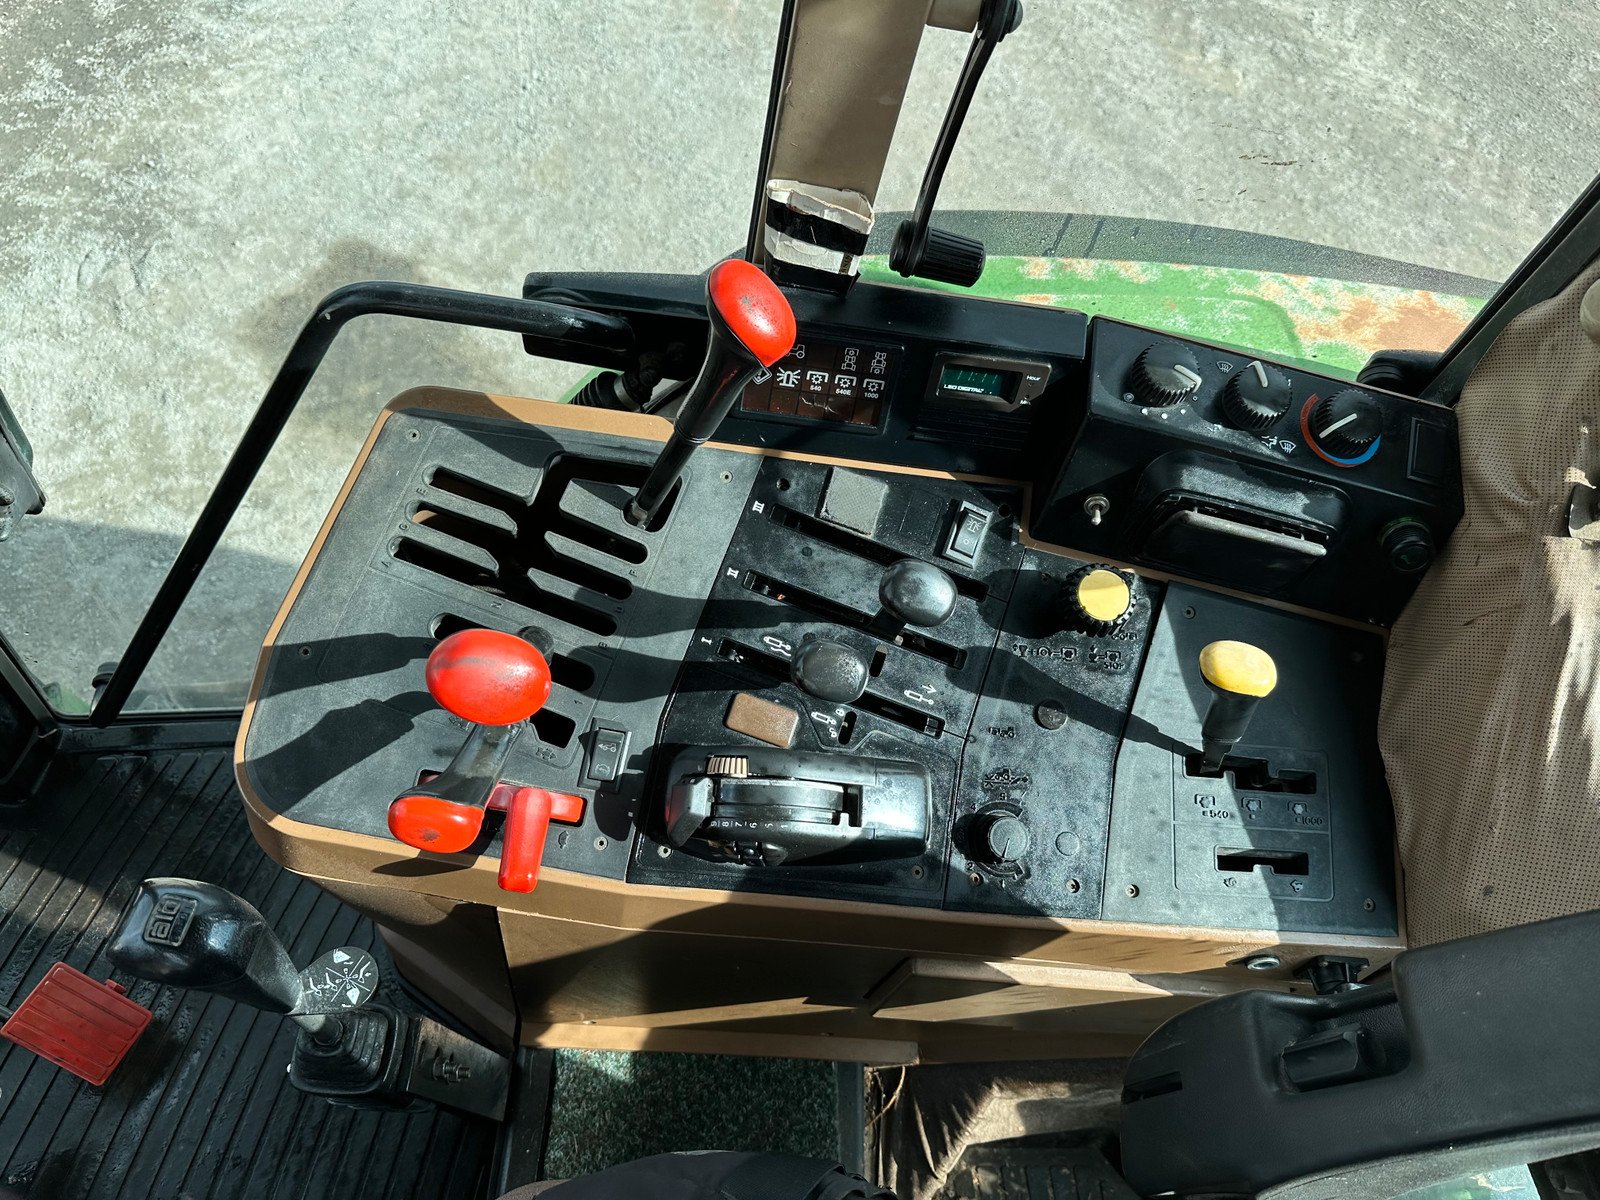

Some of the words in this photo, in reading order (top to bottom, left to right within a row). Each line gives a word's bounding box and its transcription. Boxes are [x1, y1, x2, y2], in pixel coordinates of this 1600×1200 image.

[809, 384, 822, 392] 540
[835, 388, 851, 396] 540E
[864, 391, 879, 399] 1000
[752, 500, 765, 514] III
[726, 567, 740, 579] II
